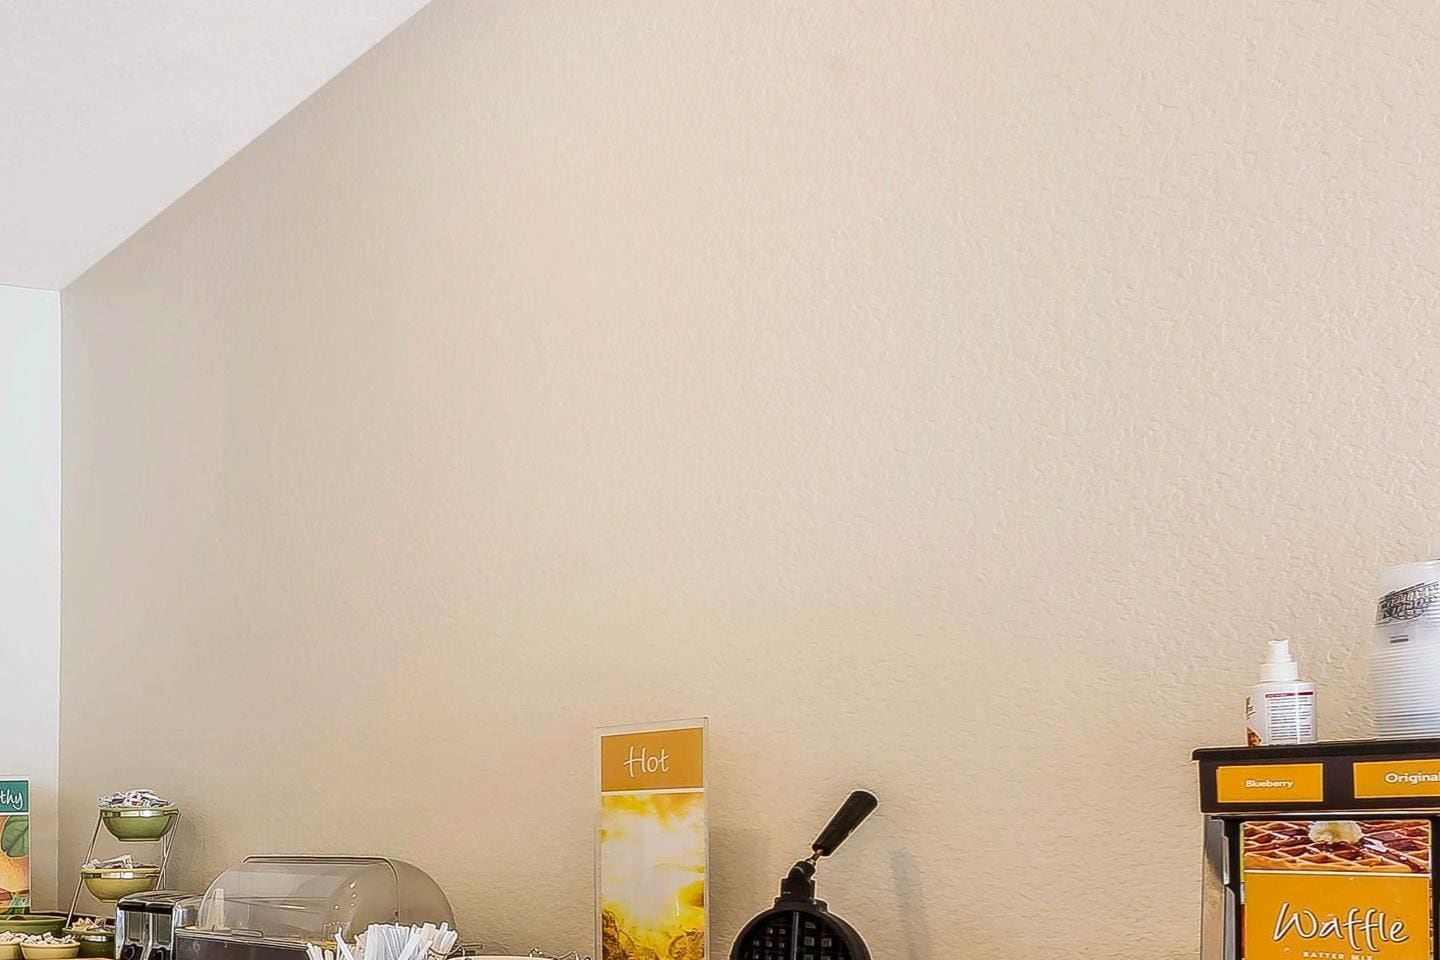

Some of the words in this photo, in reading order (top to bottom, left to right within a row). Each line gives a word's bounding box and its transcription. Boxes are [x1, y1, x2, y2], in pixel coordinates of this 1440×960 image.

[623, 745, 670, 778] Hot
[1245, 779, 1294, 788] Blueberry
[1272, 902, 1409, 952] Waffle
[1303, 951, 1345, 960] BATTER
